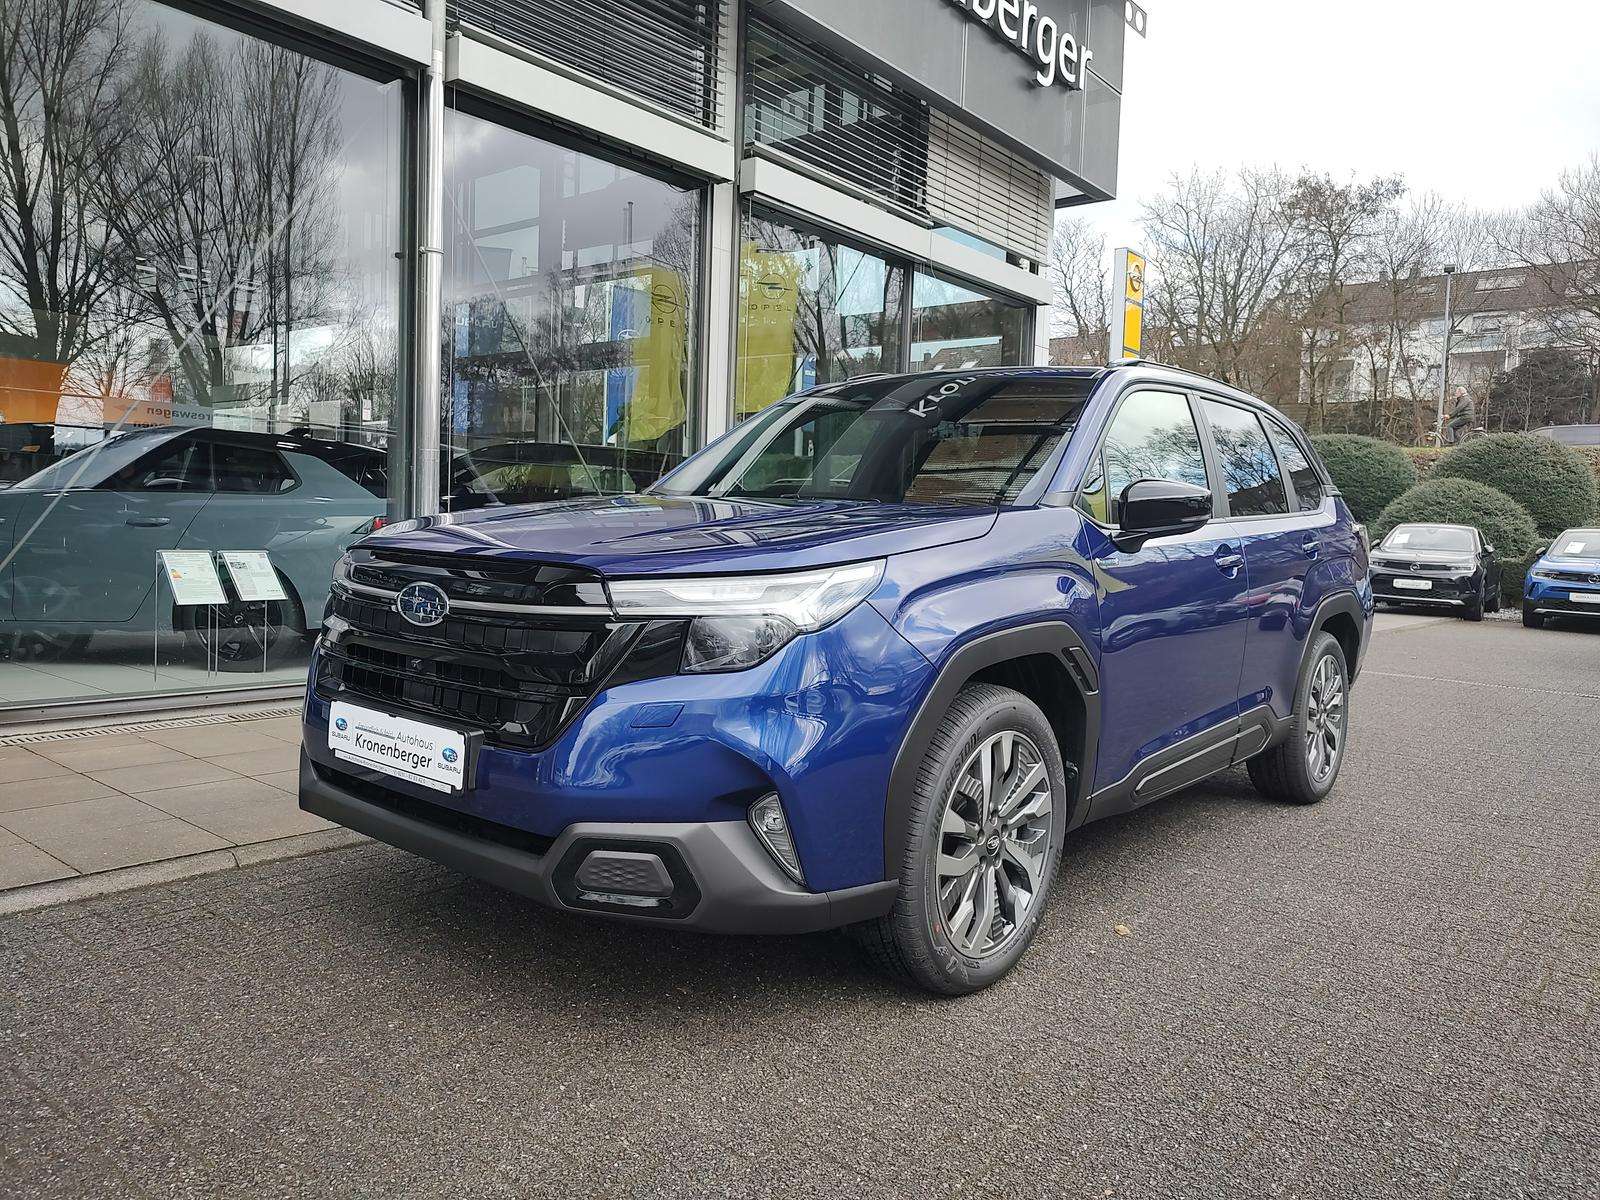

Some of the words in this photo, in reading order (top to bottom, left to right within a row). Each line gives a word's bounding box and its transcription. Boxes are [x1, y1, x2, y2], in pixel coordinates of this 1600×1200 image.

[958, 0, 1093, 90] erger
[751, 303, 792, 312] OPEL
[331, 731, 351, 742] SUBARU
[396, 731, 434, 751] Autohaus
[354, 732, 433, 768] Kronenberger
[437, 762, 462, 774] SUBARU
